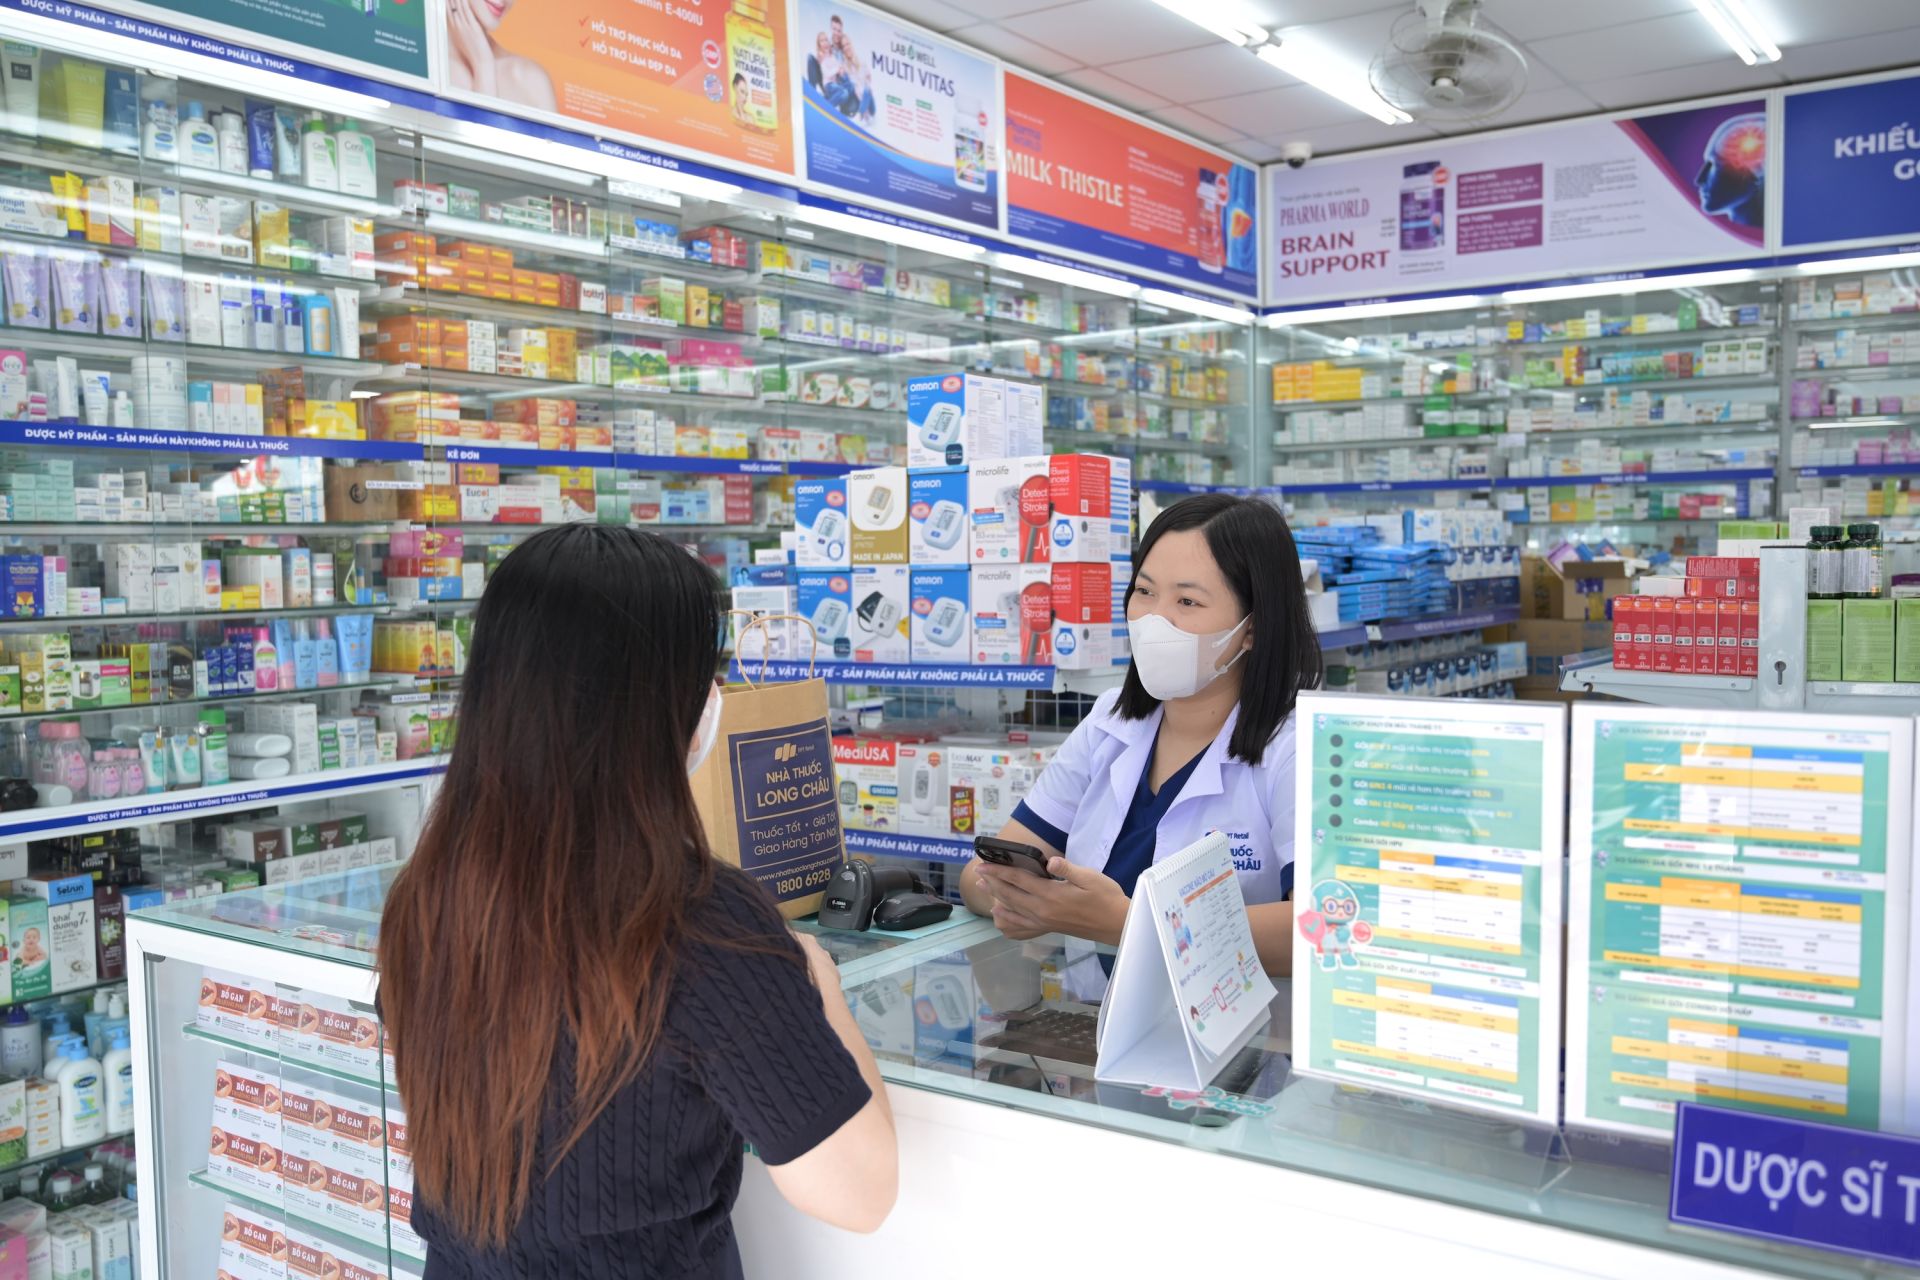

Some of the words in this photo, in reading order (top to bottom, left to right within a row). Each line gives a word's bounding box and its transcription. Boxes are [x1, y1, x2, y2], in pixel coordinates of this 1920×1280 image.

[55, 5, 73, 17] MỸ
[74, 9, 107, 27] PHẨM
[114, 18, 137, 34] SẢN
[138, 23, 168, 41] PHẨM
[169, 32, 191, 46] NÀY
[191, 37, 226, 56] KHÔNG
[226, 46, 251, 62] PHẢI
[251, 52, 263, 65] LÀ
[264, 56, 295, 74] THUỐC
[890, 41, 907, 57] LAB
[914, 50, 937, 69] WELL
[871, 52, 915, 84] MULTI
[917, 67, 956, 98] VITAS
[1006, 150, 1053, 186] MILK
[1056, 164, 1124, 208] THISTLE
[1280, 201, 1328, 227] PHARMA
[1327, 198, 1370, 220] WORLD
[1280, 231, 1355, 256] BRAIN
[1280, 250, 1390, 280] SUPPORT
[910, 382, 939, 392] OMRON
[59, 429, 74, 440] MỸ
[77, 430, 107, 443] PHẨM
[116, 432, 137, 444] SẢN
[138, 433, 167, 446] PHẨM
[223, 438, 245, 449] PHẢI
[246, 439, 258, 449] LÀ
[259, 439, 289, 451] THUỐC
[447, 449, 459, 460] KÊ
[460, 450, 480, 460] ĐƠN
[976, 467, 1010, 478] microlife
[797, 485, 824, 494] OMRON
[912, 479, 942, 489] OMRON
[1022, 488, 1048, 498] Detect
[1022, 502, 1048, 512] Stroke
[853, 551, 871, 562] MADE
[872, 552, 881, 562] IN
[881, 552, 904, 562] JAPAN
[799, 577, 827, 586] OMRON
[914, 576, 943, 585] OMRON
[977, 571, 1011, 581] microlife
[1023, 594, 1049, 604] Detect
[1023, 608, 1049, 618] Stroke
[778, 665, 797, 679] VẬT
[842, 667, 863, 679] SẢN
[863, 666, 898, 681] PHẨM
[898, 667, 920, 681] NÀY
[920, 668, 957, 682] KHÔNG
[960, 668, 990, 682] PHẢI
[991, 669, 1004, 682] LÀ
[1006, 667, 1045, 683] THUỐC
[833, 744, 890, 762] MediUSA
[766, 766, 790, 784] NHÀ
[792, 758, 822, 778] THUỐC
[756, 785, 799, 808] LONG
[801, 775, 830, 799] CHÂU
[121, 806, 142, 818] PHẨM
[147, 803, 162, 815] SẢN
[162, 801, 182, 813] PHẨM
[183, 799, 198, 811] NÀY
[198, 796, 221, 809] KHÔNG
[221, 794, 238, 805] PHẢI
[247, 791, 269, 801] THUỐC
[750, 824, 784, 842] Thuốc
[785, 820, 801, 834] Tốt
[812, 815, 826, 828] Giá
[1233, 831, 1249, 840] Retail
[754, 842, 780, 857] Giao
[782, 835, 808, 851] Hàng
[810, 831, 825, 845] Tận
[845, 835, 864, 847] SẢN
[866, 836, 897, 850] PHẨM
[897, 840, 920, 852] NÀY
[921, 842, 961, 857] KHÔNG
[1231, 844, 1253, 857] UỐC
[776, 876, 802, 895] 1800
[805, 868, 831, 887] 6928
[220, 985, 230, 1000] BỔ
[230, 990, 244, 1003] GAN
[278, 1006, 293, 1017] GAN
[324, 1012, 334, 1027] BỔ
[334, 1017, 350, 1031] GAN
[236, 1077, 246, 1092] BỔ
[245, 1084, 260, 1097] GAN
[284, 1093, 294, 1108] BỔ
[293, 1099, 309, 1113] GAN
[336, 1110, 346, 1124] BỔ
[346, 1116, 362, 1129] GAN
[231, 1135, 241, 1150] BỔ
[240, 1141, 255, 1155] GAN
[288, 1160, 304, 1173] GAN
[331, 1172, 341, 1186] BỔ
[342, 1177, 357, 1191] GAN
[1693, 1142, 1828, 1212] DƯỢC
[1839, 1160, 1888, 1219] SĨ
[390, 1189, 400, 1204] BỔ
[400, 1196, 412, 1209] GA
[244, 1222, 253, 1237] BỔ
[252, 1229, 267, 1243] GAN
[291, 1243, 301, 1257] BỔ
[301, 1250, 316, 1264] GAN
